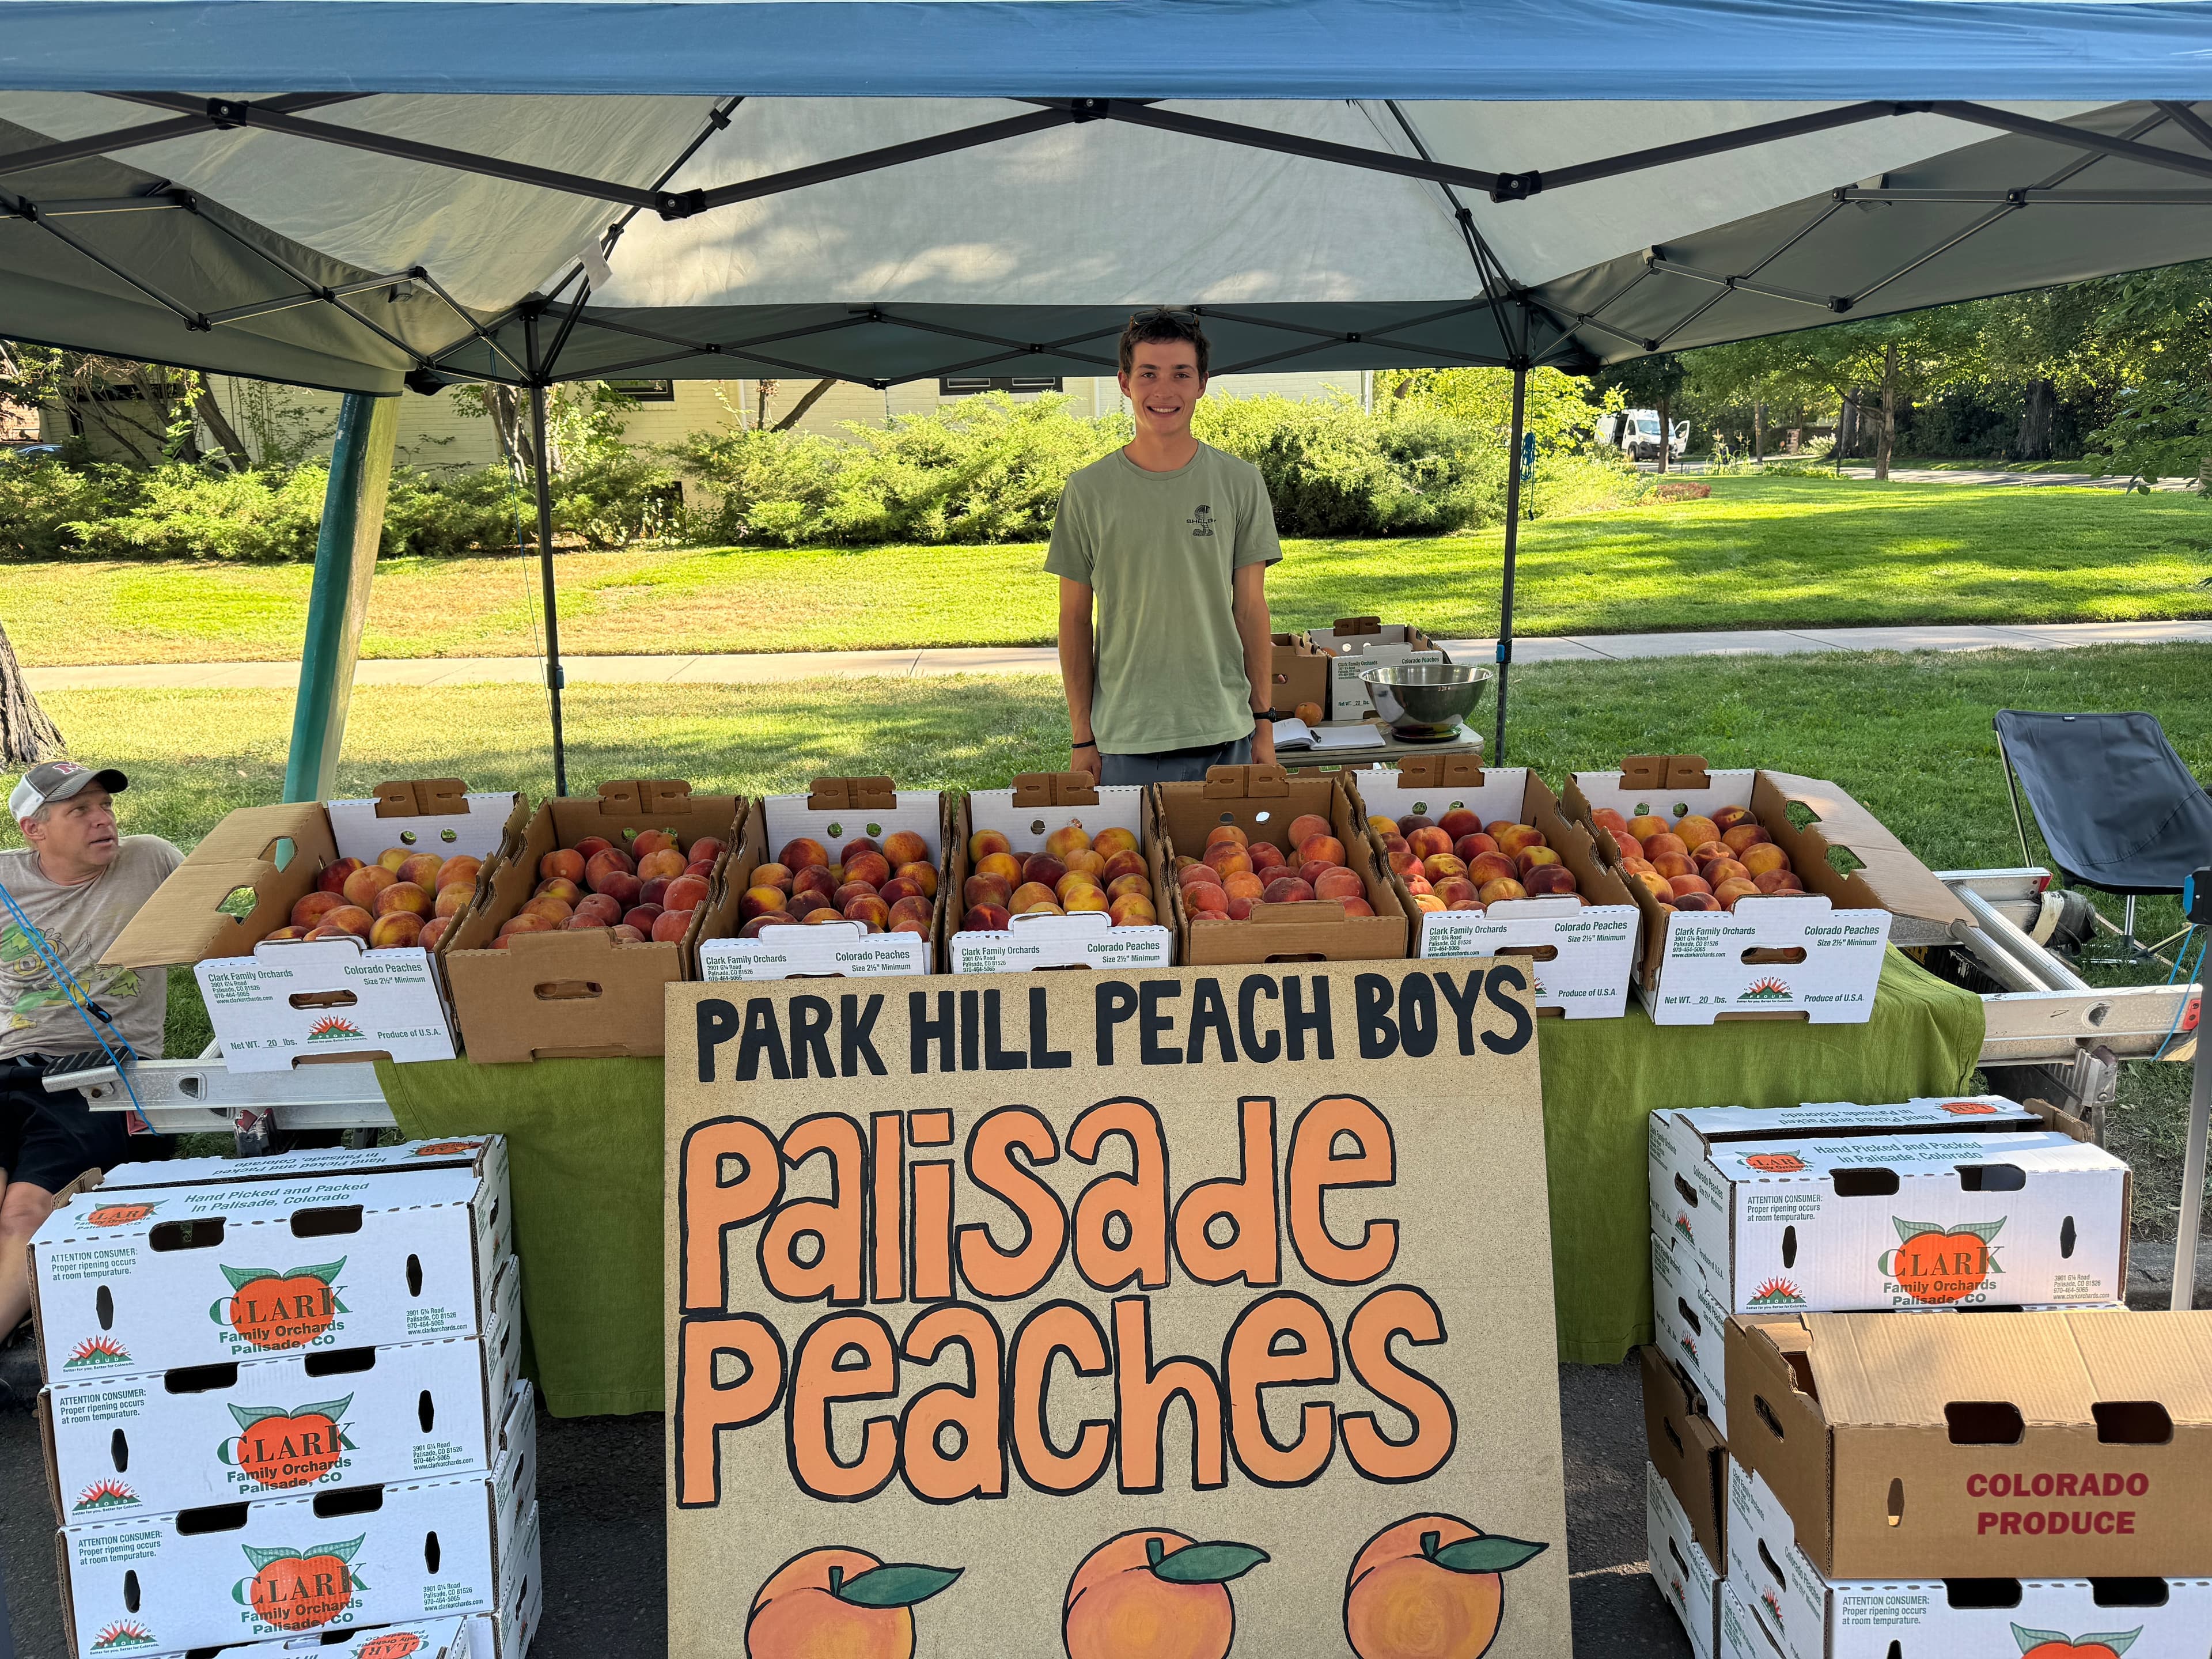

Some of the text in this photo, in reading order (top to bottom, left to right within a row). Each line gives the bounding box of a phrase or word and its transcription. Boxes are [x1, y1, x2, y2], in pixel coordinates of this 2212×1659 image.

[1429, 925, 1507, 935] Clark Family Orchards
[1554, 921, 1627, 931] Colorado Peaches
[1675, 927, 1694, 935] Clark
[1696, 927, 1720, 935] Family
[1804, 925, 1879, 935] Colorado Peaches
[961, 946, 1039, 956] Clark Family Orchards
[1087, 942, 1160, 952] Colorado Peaches
[706, 955, 786, 964] Clark Family Orchards
[835, 950, 910, 961] Colorado Peaches
[344, 963, 422, 974] Colorado Peaches
[208, 969, 293, 982] Clark Family Orchards
[1558, 989, 1586, 997] Produce
[1714, 995, 1727, 1003] lbs.
[695, 968, 1535, 1084] PARK HILL PEACH BOYS
[377, 1031, 408, 1039] Produce
[230, 1041, 243, 1050] Net
[245, 1040, 259, 1050] WT.
[267, 1039, 277, 1047] 20
[283, 1038, 297, 1047] lbs.
[1813, 1141, 1983, 1154] Hand Picked and Packed
[1838, 1152, 1983, 1163] In Palisade, Colorado
[184, 1183, 370, 1203] Hand Picked and Packed
[1748, 1195, 1823, 1204] ATTENTION CONSUMER:
[191, 1194, 350, 1213] In Palisade, Colorado
[679, 1092, 1400, 1315] Palisade
[1748, 1206, 1769, 1214] Proper
[1771, 1205, 1797, 1213] ripening
[1774, 1213, 1815, 1222] tempurature.
[51, 1248, 137, 1262] ATTENTION CONSUMER:
[1878, 1246, 2006, 1277] CLARK
[51, 1259, 136, 1272] Proper ripening occurs
[83, 1268, 131, 1278] tempurature.
[1883, 1279, 1997, 1294] Family Orchards
[1892, 1293, 1986, 1305] Palisade, CO
[209, 1286, 353, 1326] CLARK
[407, 1320, 444, 1329] 970-464-5065
[408, 1324, 467, 1335] www.clarkorchards.com
[219, 1320, 344, 1343] Family Orchards
[232, 1335, 335, 1355] Palisade, CO
[77, 1357, 119, 1365] PROUD
[60, 1389, 146, 1406] ATTENTION CONSUMER:
[677, 1284, 1457, 1510] Peaches
[60, 1399, 144, 1415] Proper ripening occurs
[62, 1410, 139, 1424] at room tempurature.
[217, 1422, 360, 1465] CLARK
[227, 1457, 351, 1483] Family Orchards
[240, 1472, 342, 1494] Palisade, CO
[1967, 1472, 2149, 1499] COLORADO
[1977, 1512, 2135, 1536] PRODUCE
[232, 1562, 372, 1606] CLARK
[241, 1598, 363, 1622] Family Orchards
